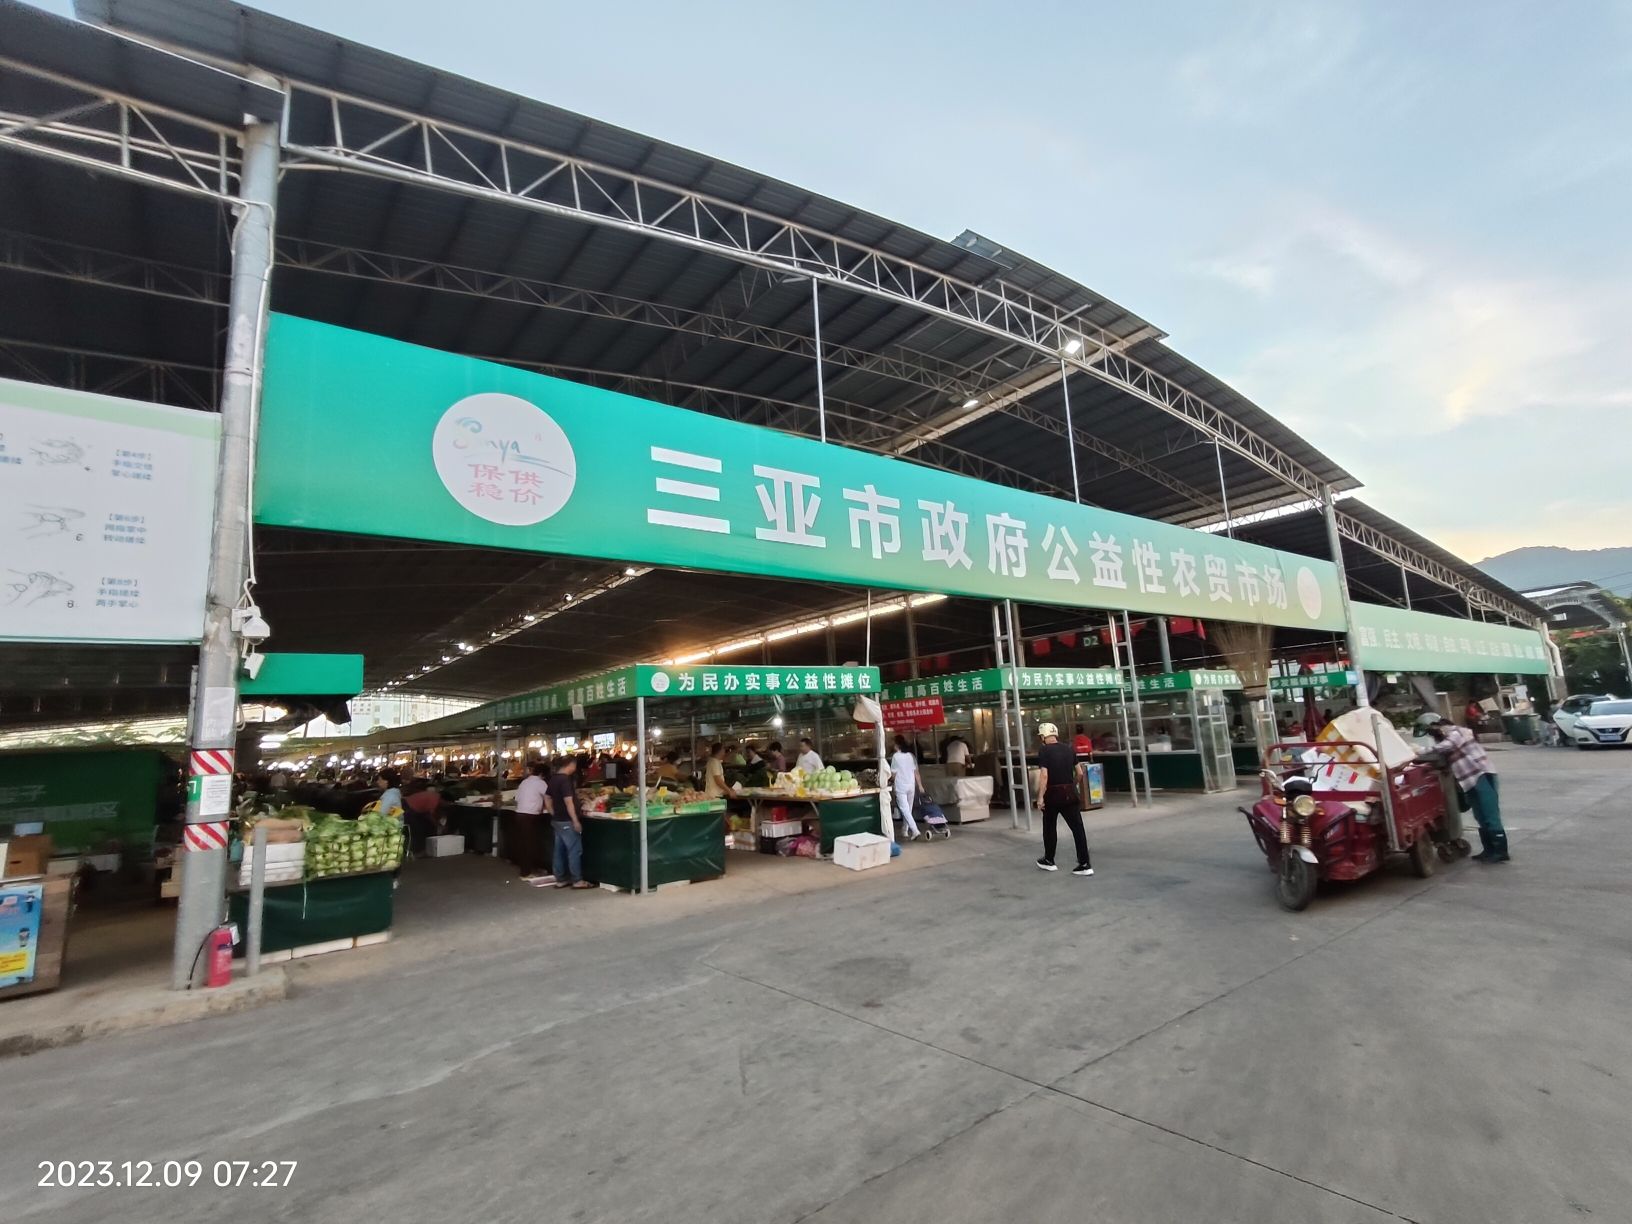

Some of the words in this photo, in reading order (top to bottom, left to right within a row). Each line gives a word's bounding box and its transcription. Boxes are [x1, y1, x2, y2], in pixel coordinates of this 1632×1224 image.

[647, 445, 1288, 611] 三亚市政府公益性农贸市场
[1083, 636, 1100, 647] D2
[678, 672, 872, 691] 为民办实事公益性摊位
